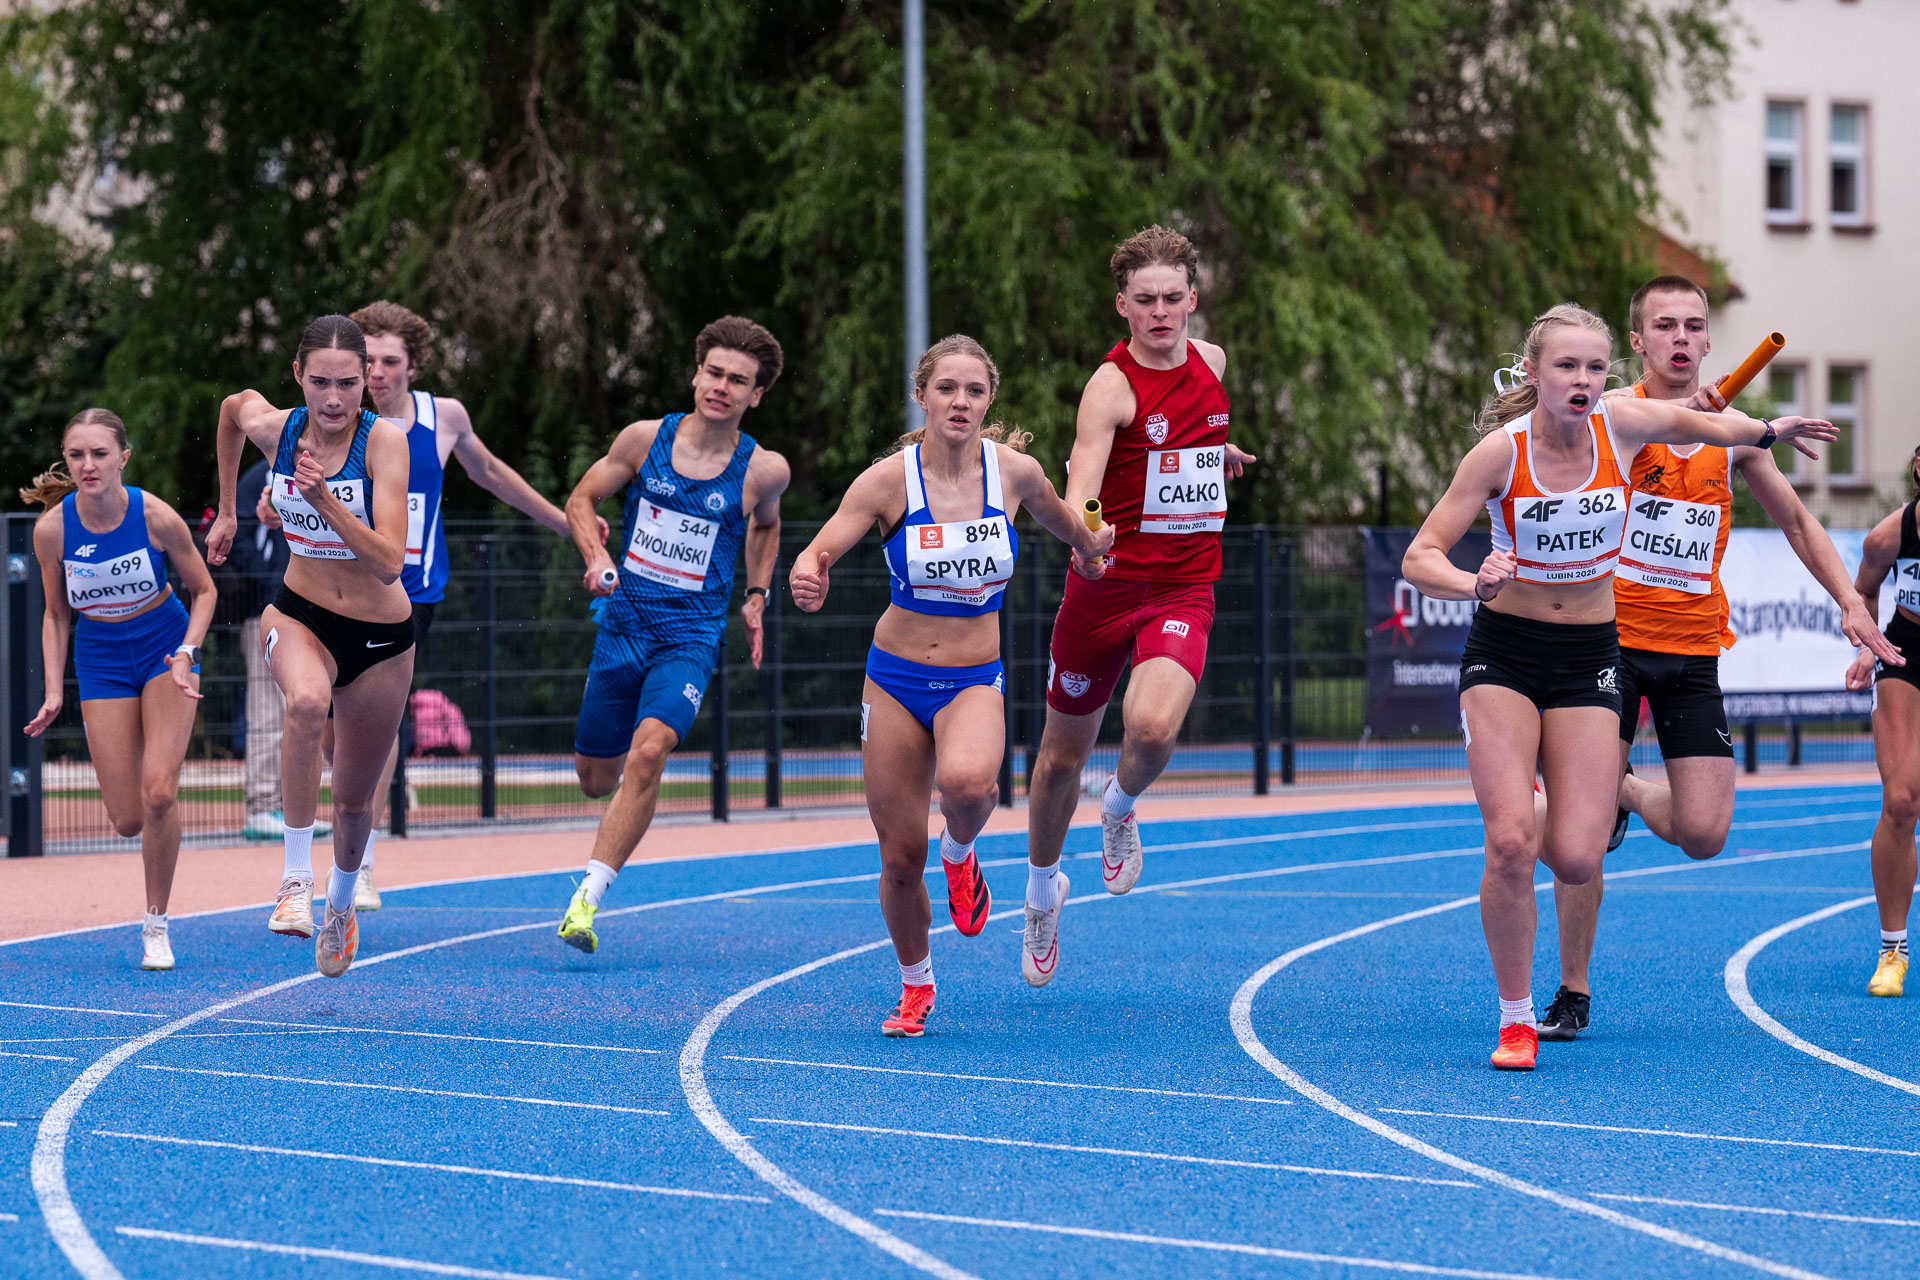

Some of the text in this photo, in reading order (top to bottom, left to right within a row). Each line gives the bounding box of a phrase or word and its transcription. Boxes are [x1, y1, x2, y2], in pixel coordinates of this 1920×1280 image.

[1196, 451, 1221, 469] 886
[333, 486, 354, 502] 43
[1158, 482, 1219, 504] CAŁKO
[1521, 499, 1564, 522] 4F
[1578, 493, 1617, 515] 362
[1635, 499, 1674, 521] 4F
[1167, 521, 1207, 531] LUBIN 2026
[1684, 508, 1716, 527] 360
[678, 519, 710, 538] 544
[966, 522, 1001, 543] 894
[634, 528, 708, 567] ZWOLIŃSKI
[1536, 526, 1607, 553] PATEK
[1630, 529, 1711, 561] CIEŚLAK
[74, 543, 97, 558] 4F
[304, 547, 327, 556] LUBIN
[110, 556, 142, 576] 699
[925, 556, 998, 580] SPYRA
[1546, 568, 1597, 580] LUBIN 2026
[1903, 562, 1920, 581] 4
[640, 567, 660, 582] LUBIN
[661, 574, 679, 585] 2026
[1642, 574, 1689, 588] LUBIN 2026
[71, 580, 153, 603] MORYTO
[942, 593, 967, 602] LUBIN
[1898, 588, 1920, 606] PIET
